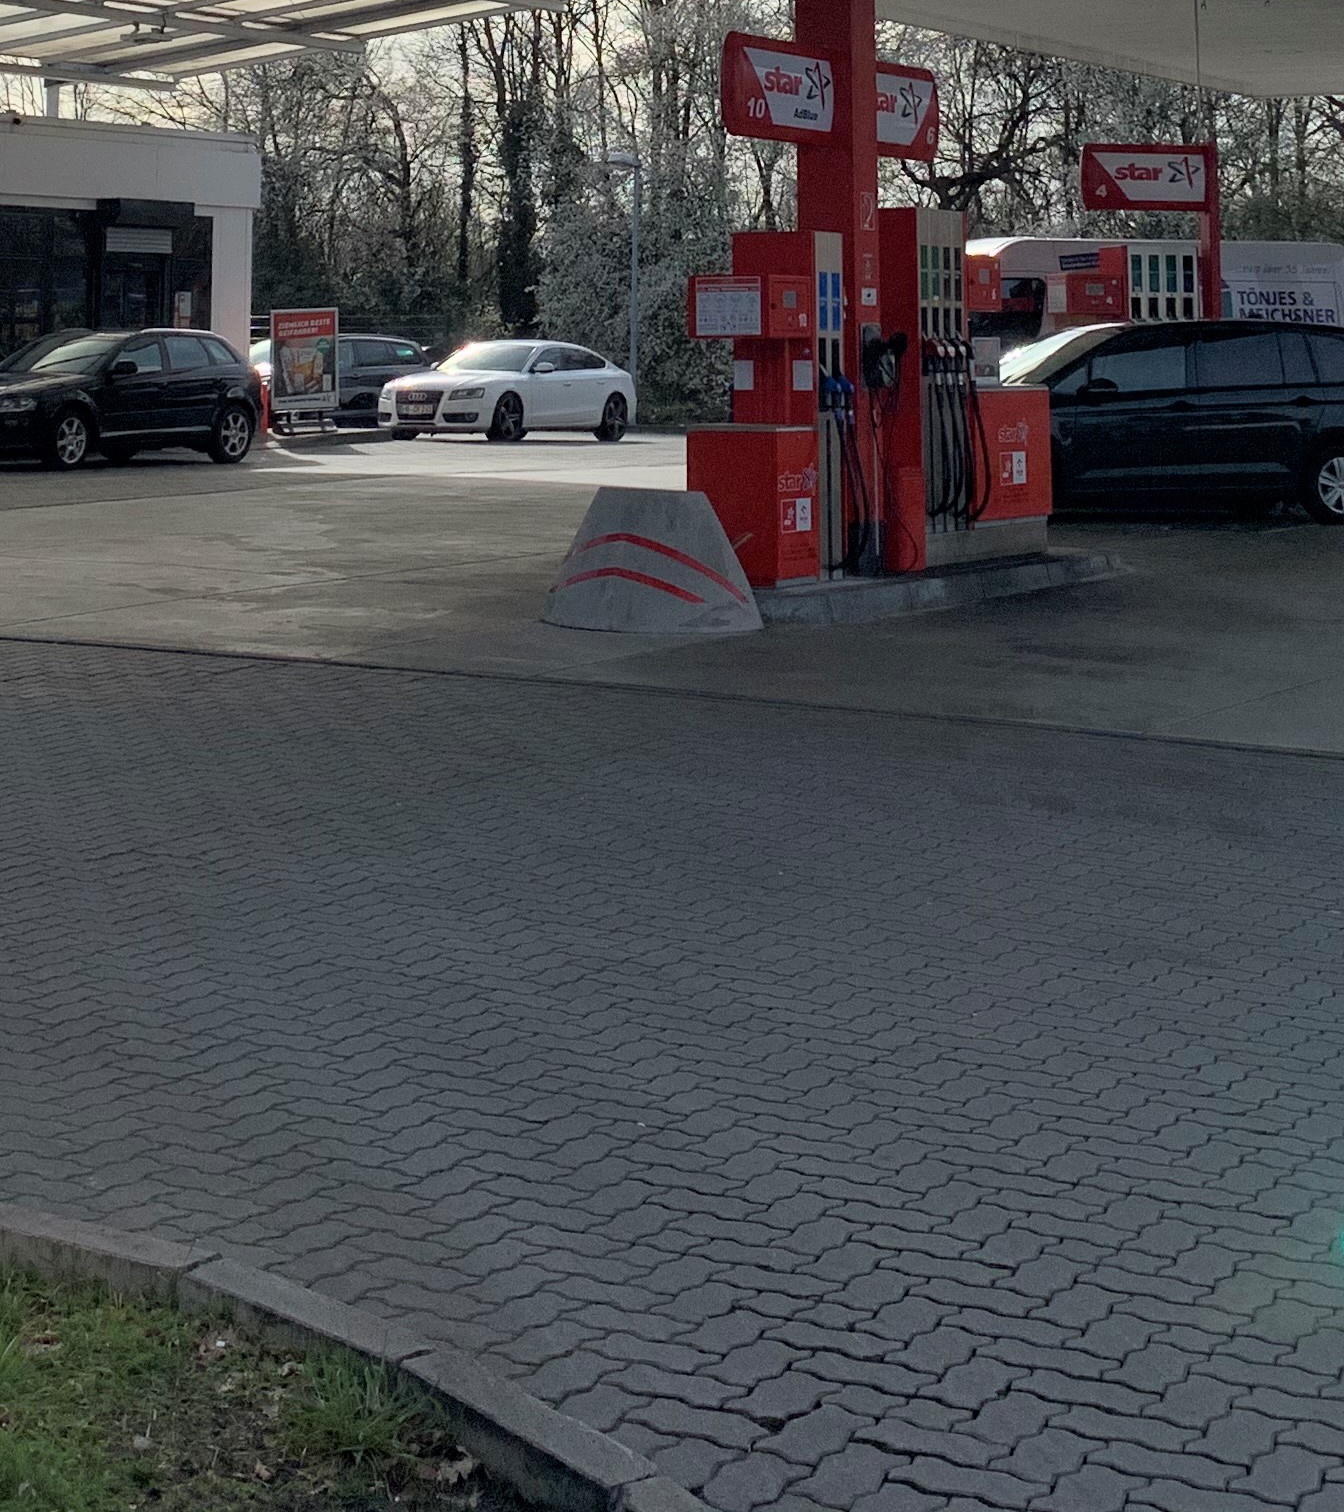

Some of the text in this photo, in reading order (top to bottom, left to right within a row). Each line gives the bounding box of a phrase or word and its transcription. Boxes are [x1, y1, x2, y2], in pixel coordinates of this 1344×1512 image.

[764, 66, 803, 96] star
[747, 97, 765, 119] 10
[794, 107, 819, 122] AdBlue
[926, 127, 935, 145] 6
[1114, 162, 1163, 181] star
[1096, 184, 1107, 198] 4
[1237, 288, 1314, 306] TÖNJES &
[1239, 308, 1335, 323] MEICHSNER
